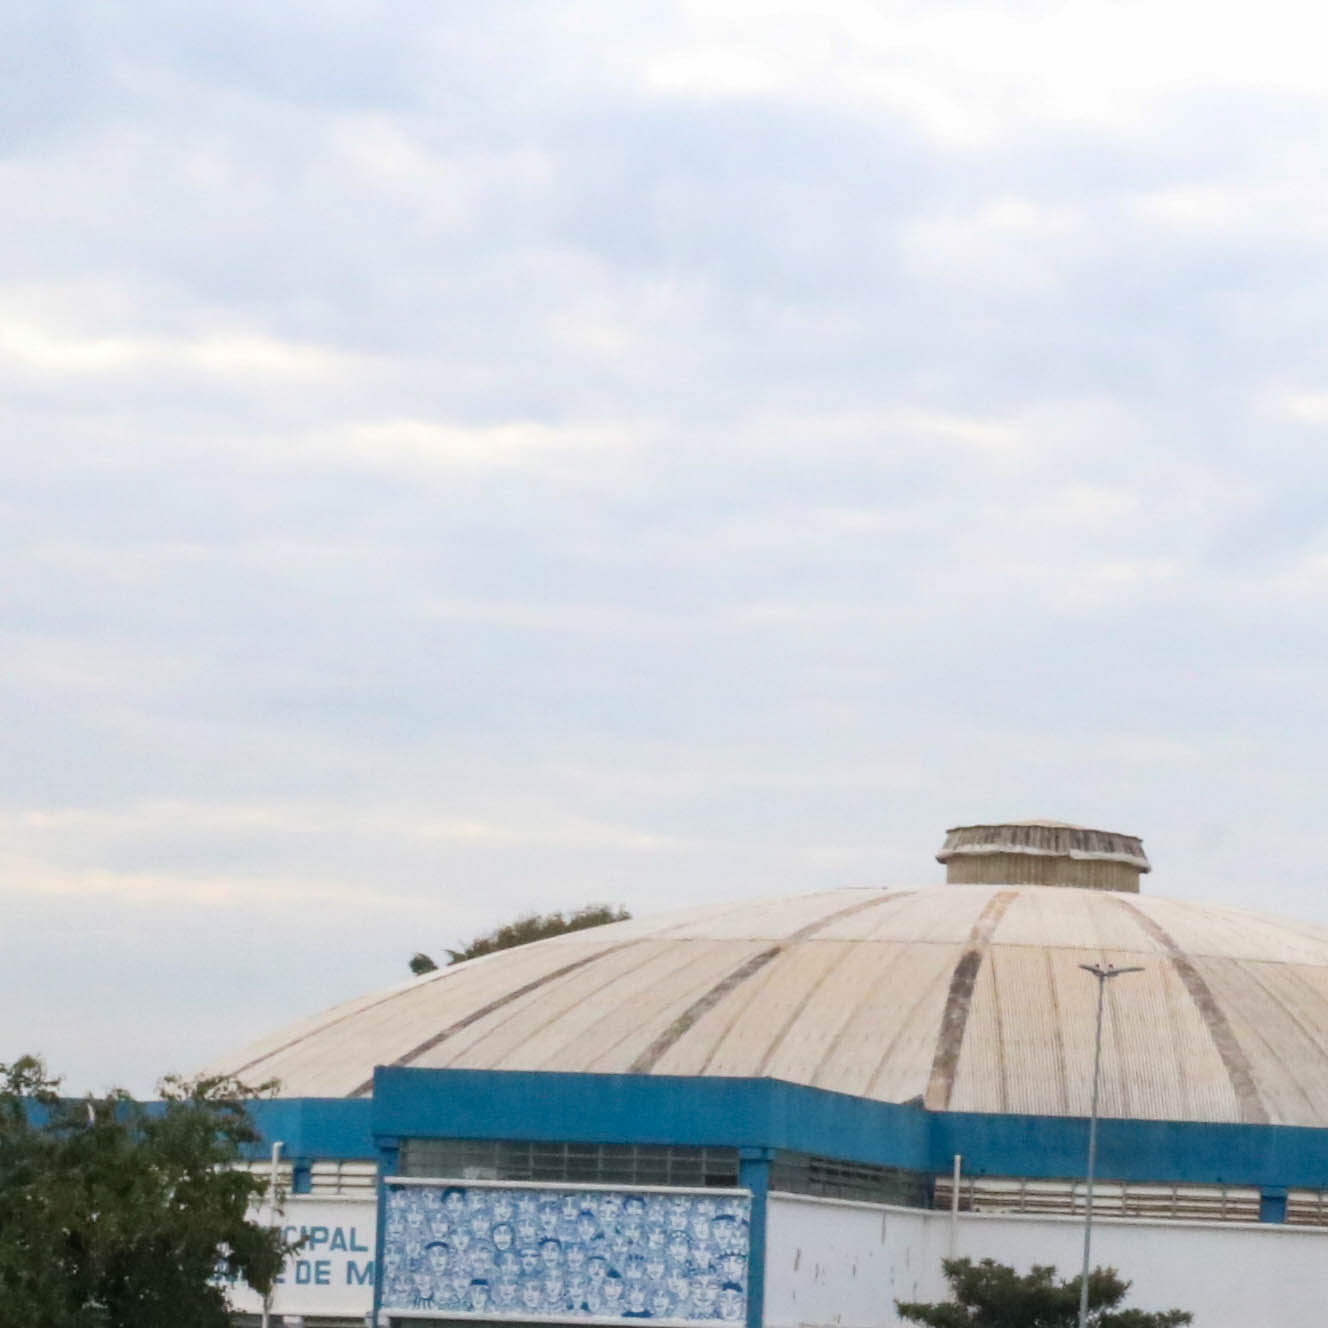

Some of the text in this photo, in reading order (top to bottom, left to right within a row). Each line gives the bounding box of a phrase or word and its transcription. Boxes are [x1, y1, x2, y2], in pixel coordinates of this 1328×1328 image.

[278, 1225, 369, 1252] CIPAL
[296, 1260, 332, 1285] DE
[346, 1260, 376, 1286] M
